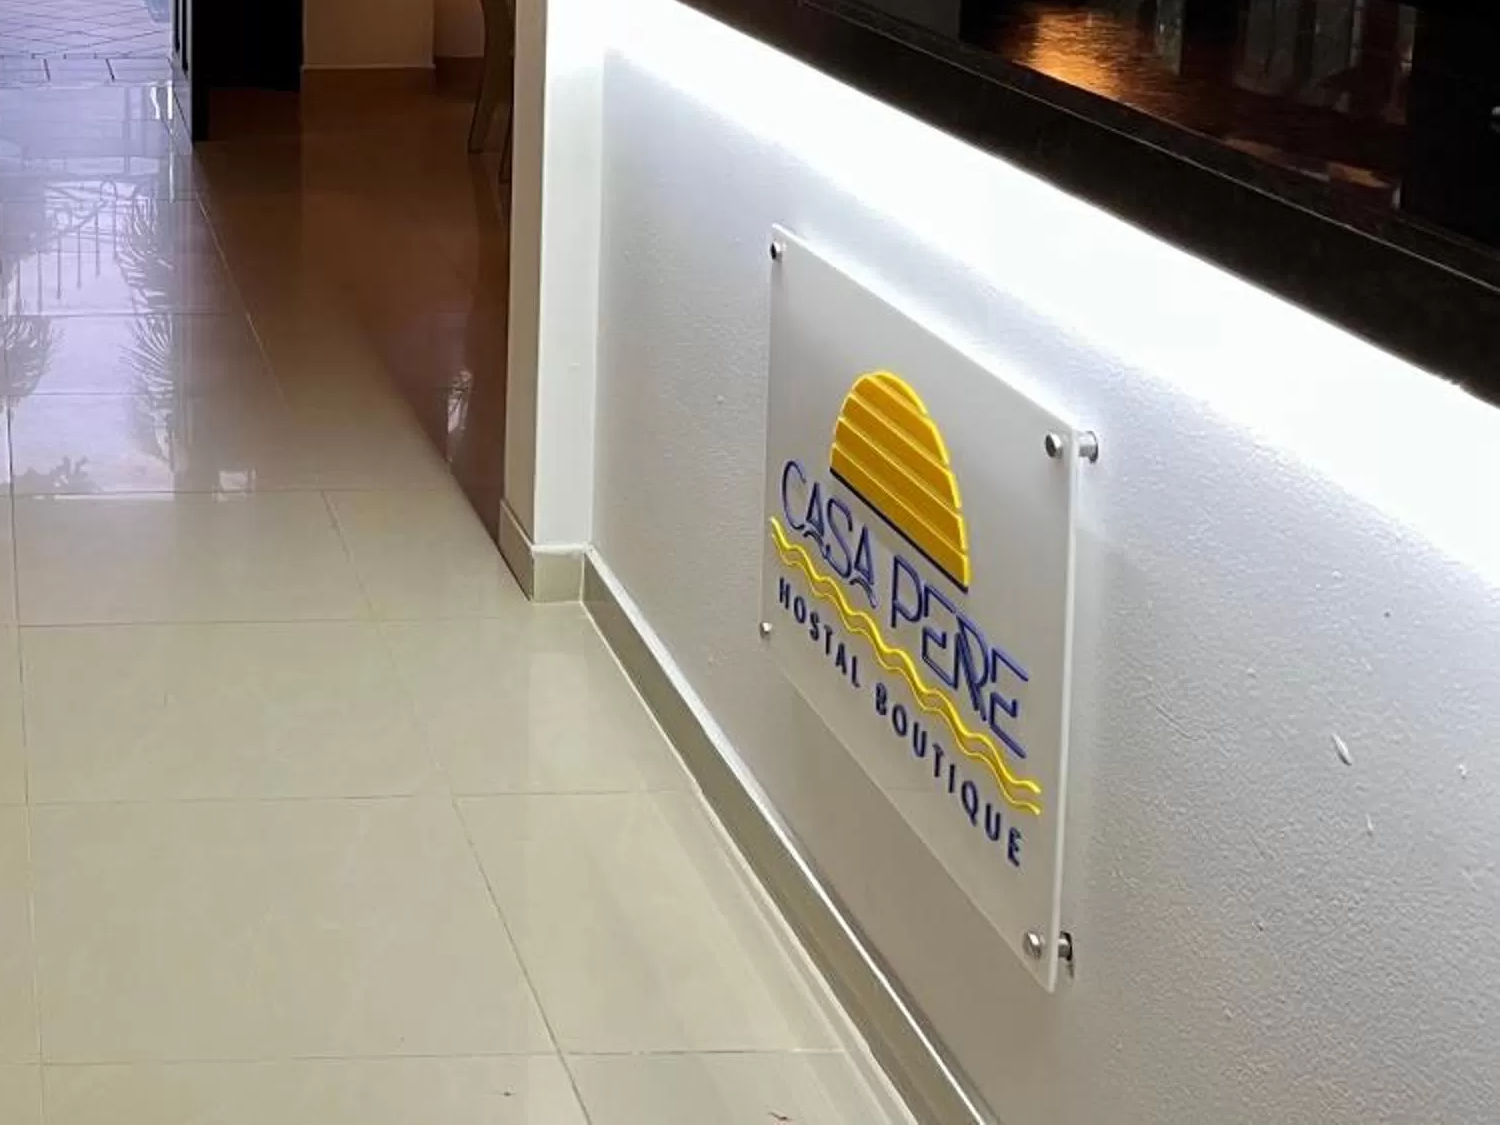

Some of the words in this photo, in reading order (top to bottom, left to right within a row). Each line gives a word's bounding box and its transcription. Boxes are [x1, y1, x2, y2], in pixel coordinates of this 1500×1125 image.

[778, 577, 861, 688] HOSTAL
[875, 682, 1020, 867] BOUTIQUE
[781, 458, 879, 609] CASA
[890, 554, 1029, 759] PERE
